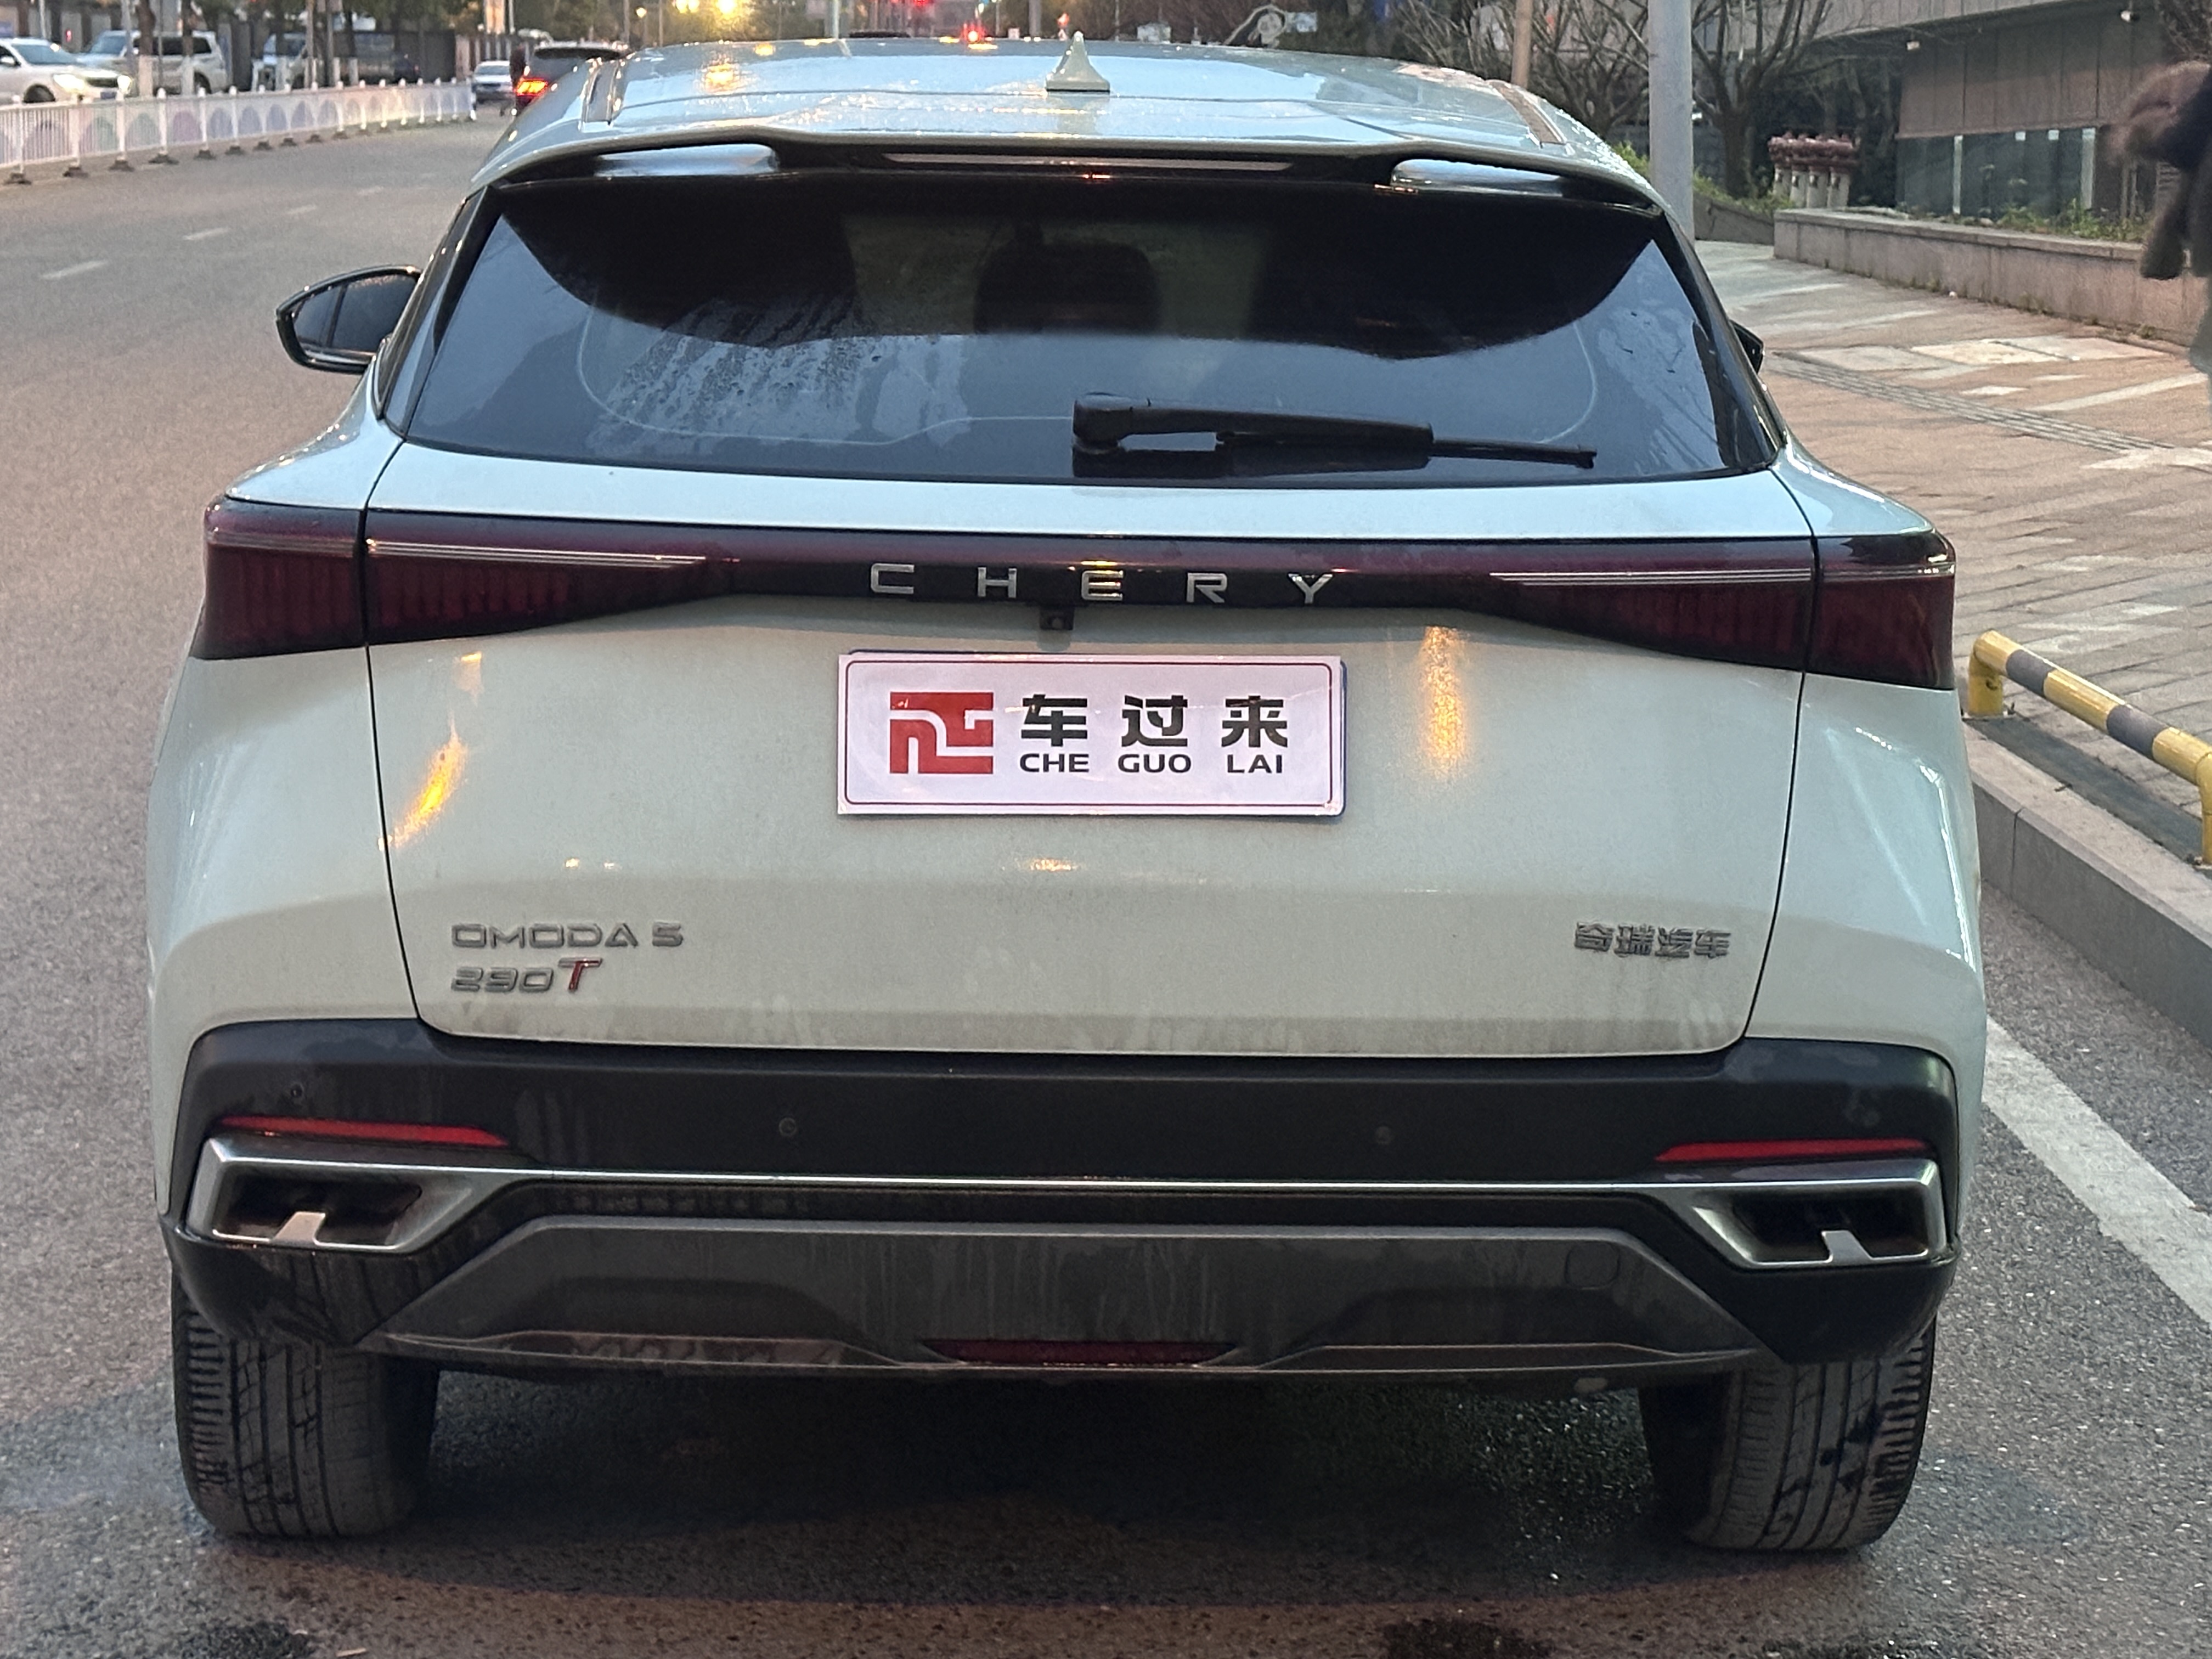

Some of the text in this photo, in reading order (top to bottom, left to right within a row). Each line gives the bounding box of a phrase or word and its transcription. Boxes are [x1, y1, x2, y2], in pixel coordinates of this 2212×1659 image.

[870, 562, 1333, 604] CHERY
[1019, 753, 1282, 774] CHE GUO LAI
[451, 922, 683, 948] OMODA 5
[1575, 922, 1731, 958] 奇瑞汽车
[451, 957, 603, 992] 290T
